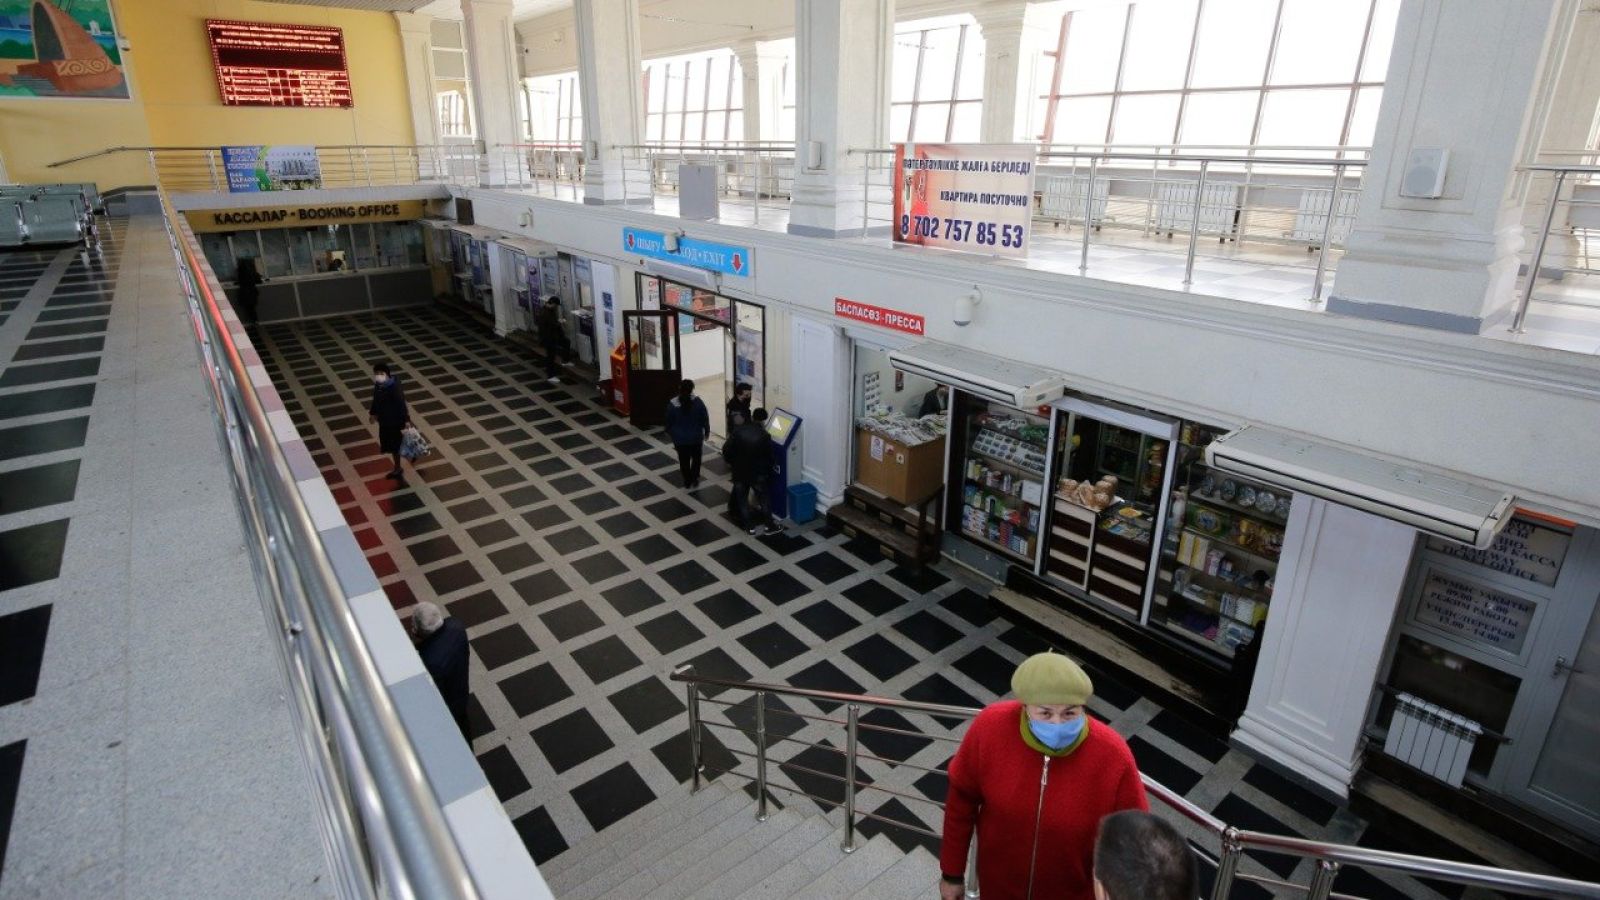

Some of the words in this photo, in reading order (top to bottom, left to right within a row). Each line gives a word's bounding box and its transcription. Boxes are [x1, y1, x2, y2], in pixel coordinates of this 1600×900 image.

[940, 190, 978, 203] КВАРТИРА
[979, 193, 1028, 207] ПОСУТОЧНО
[214, 210, 287, 225] КАССАЛАР
[299, 205, 356, 220] BOOKING
[358, 203, 400, 217] OFFICE
[901, 214, 910, 236] 8
[914, 215, 940, 238] 702
[944, 218, 972, 242] 757
[976, 221, 996, 246] 85
[1001, 223, 1024, 248] 53
[703, 251, 725, 266] EXIT
[885, 313, 922, 331] ПРЕССА
[1510, 549, 1556, 568] КАССА
[1473, 605, 1519, 627] РАБОТЫ
